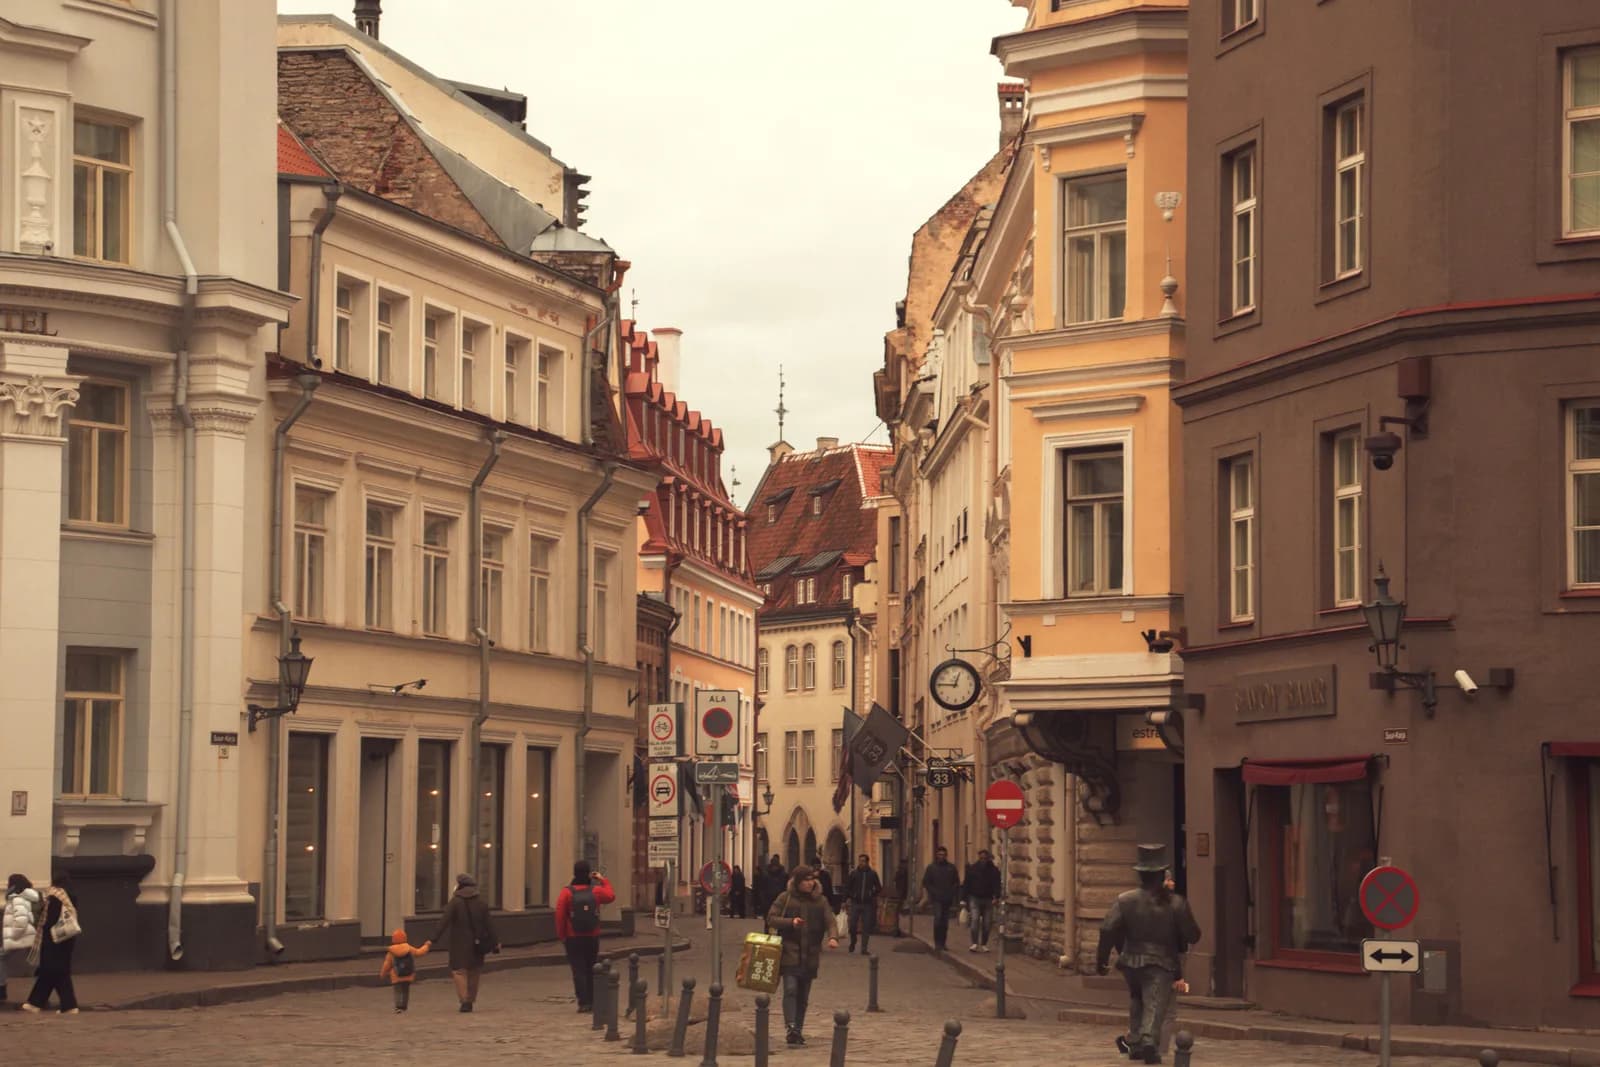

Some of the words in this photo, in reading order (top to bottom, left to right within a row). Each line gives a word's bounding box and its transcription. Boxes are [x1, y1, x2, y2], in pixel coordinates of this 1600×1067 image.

[933, 772, 949, 785] 33
[751, 961, 764, 981] Bolt
[762, 958, 775, 984] Food
